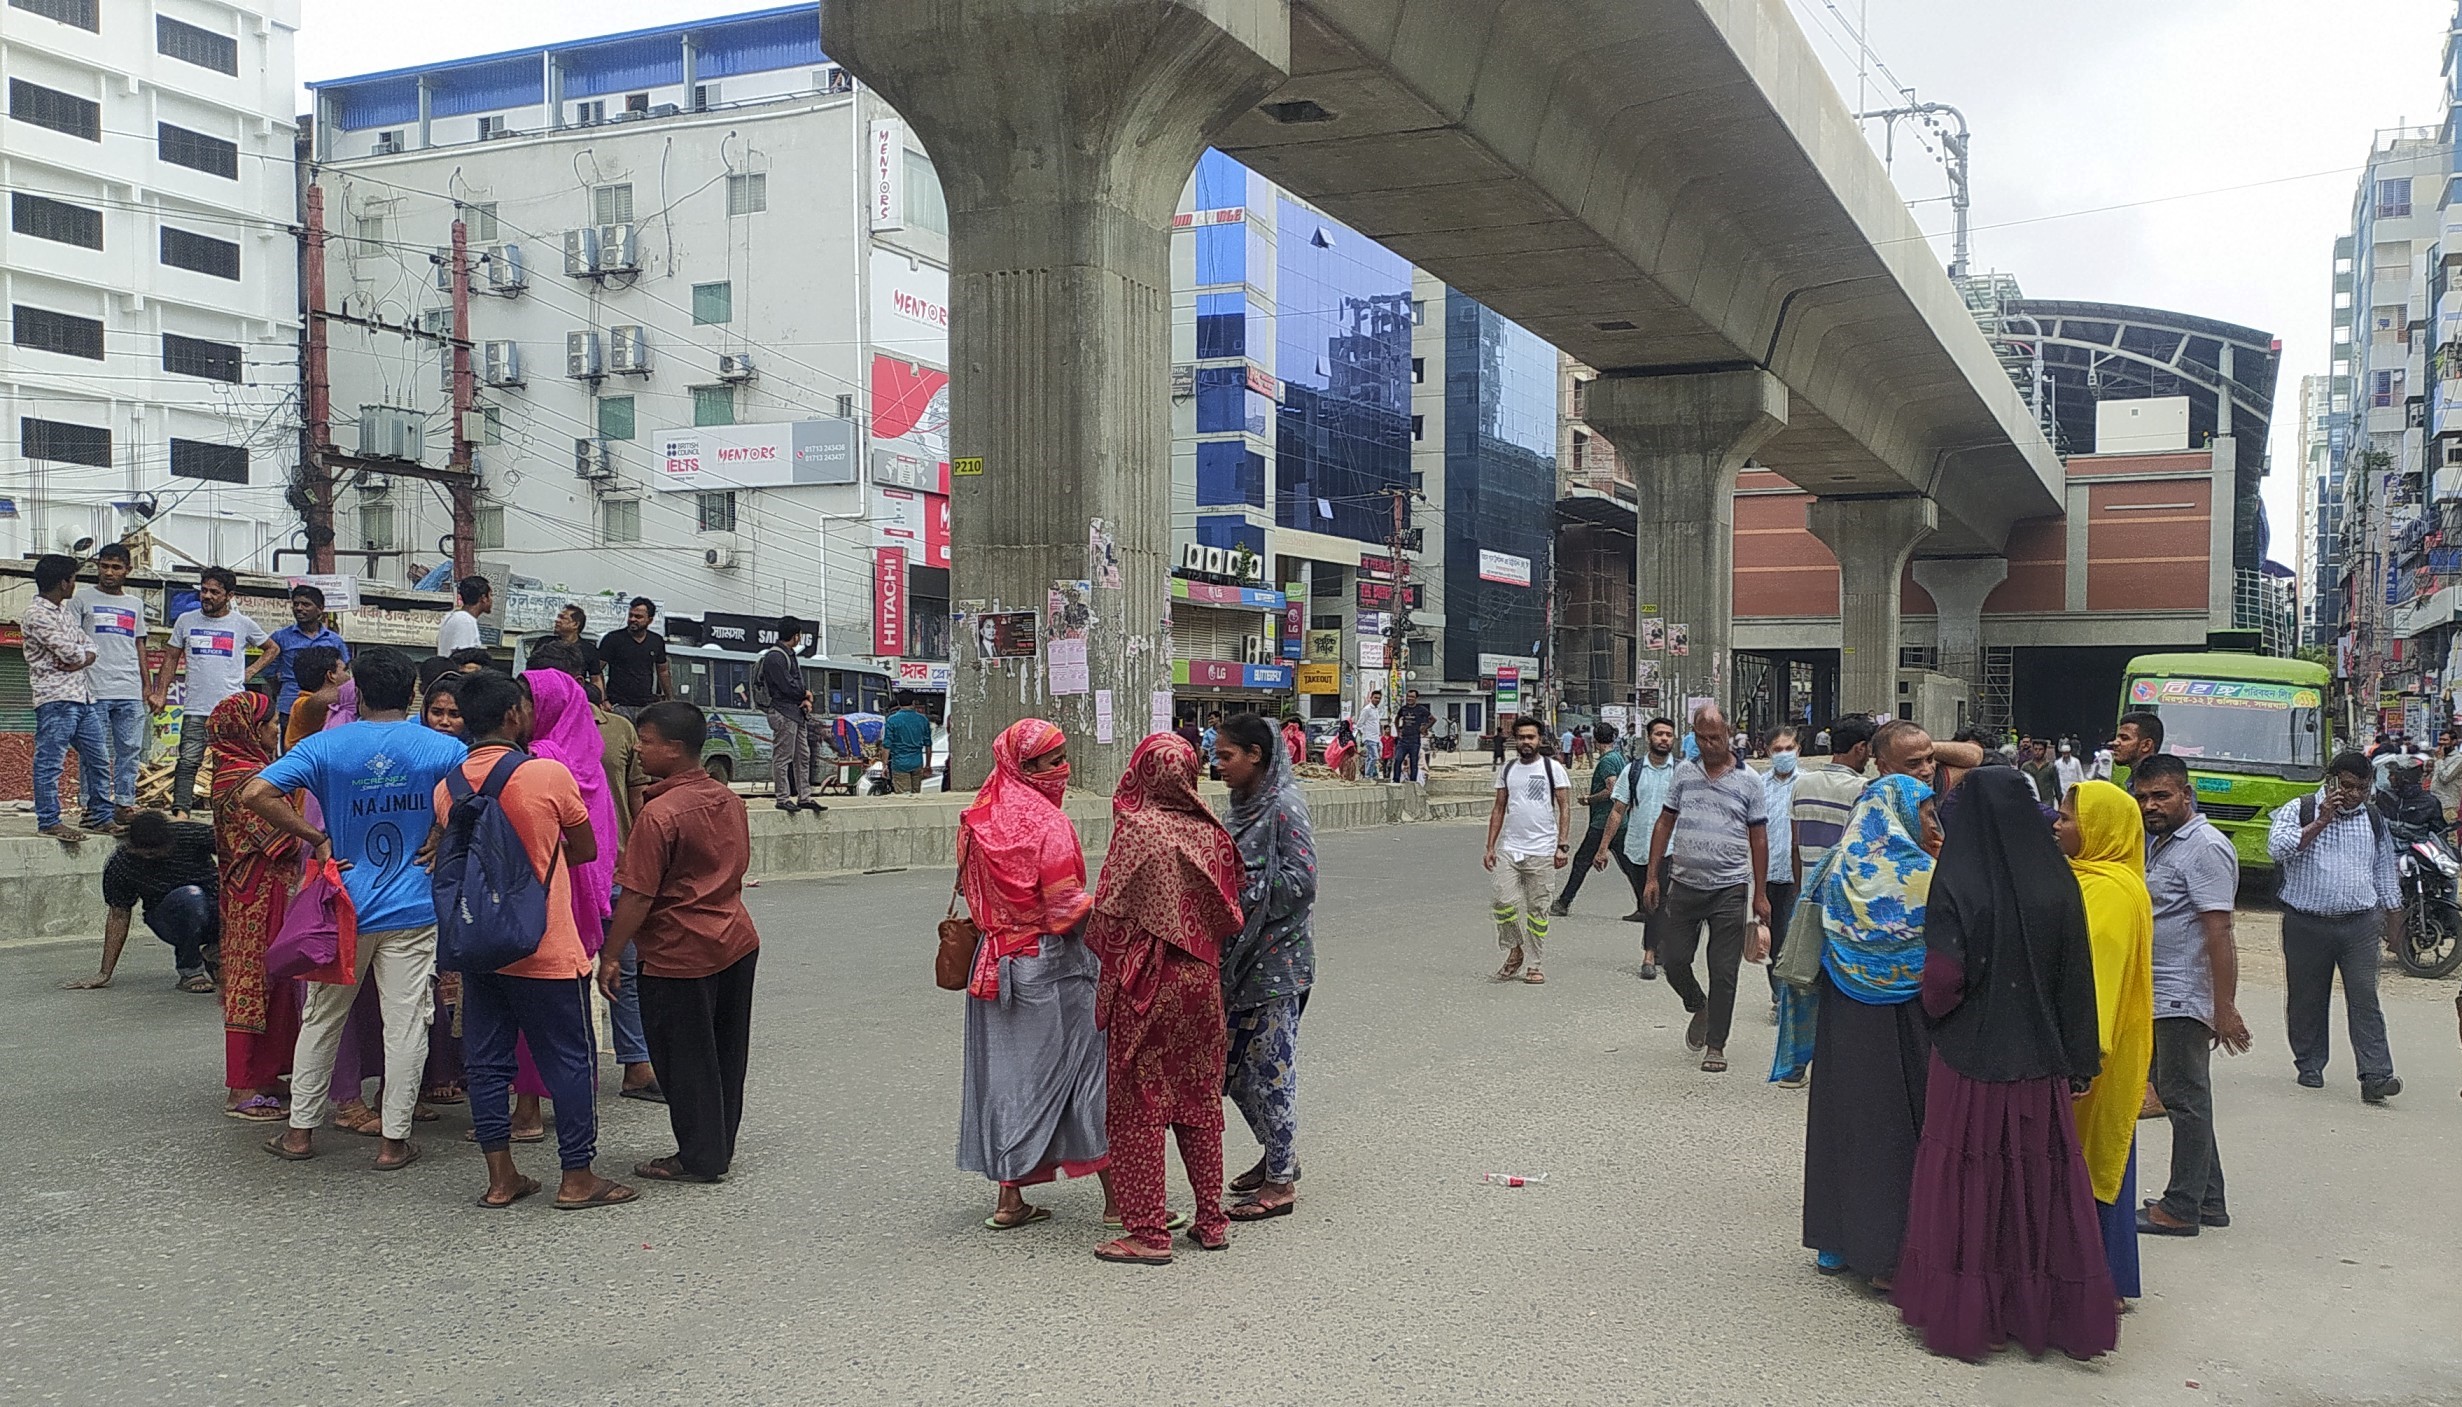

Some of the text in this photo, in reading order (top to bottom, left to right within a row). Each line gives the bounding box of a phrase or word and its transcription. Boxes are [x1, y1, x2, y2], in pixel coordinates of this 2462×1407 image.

[879, 130, 890, 220] MENTORS
[894, 289, 949, 326] MENTOR
[718, 446, 776, 462] MENTORS
[805, 445, 823, 453] 01713
[667, 458, 699, 472] IELTS
[805, 454, 823, 462] 01713
[955, 460, 982, 472] P210
[884, 558, 896, 645] HITACHI
[1288, 625, 1298, 633] LG
[1216, 667, 1226, 679] LG
[1304, 675, 1333, 685] TAKEOUT
[352, 793, 427, 817] NAJMUL
[366, 821, 403, 890] 9
